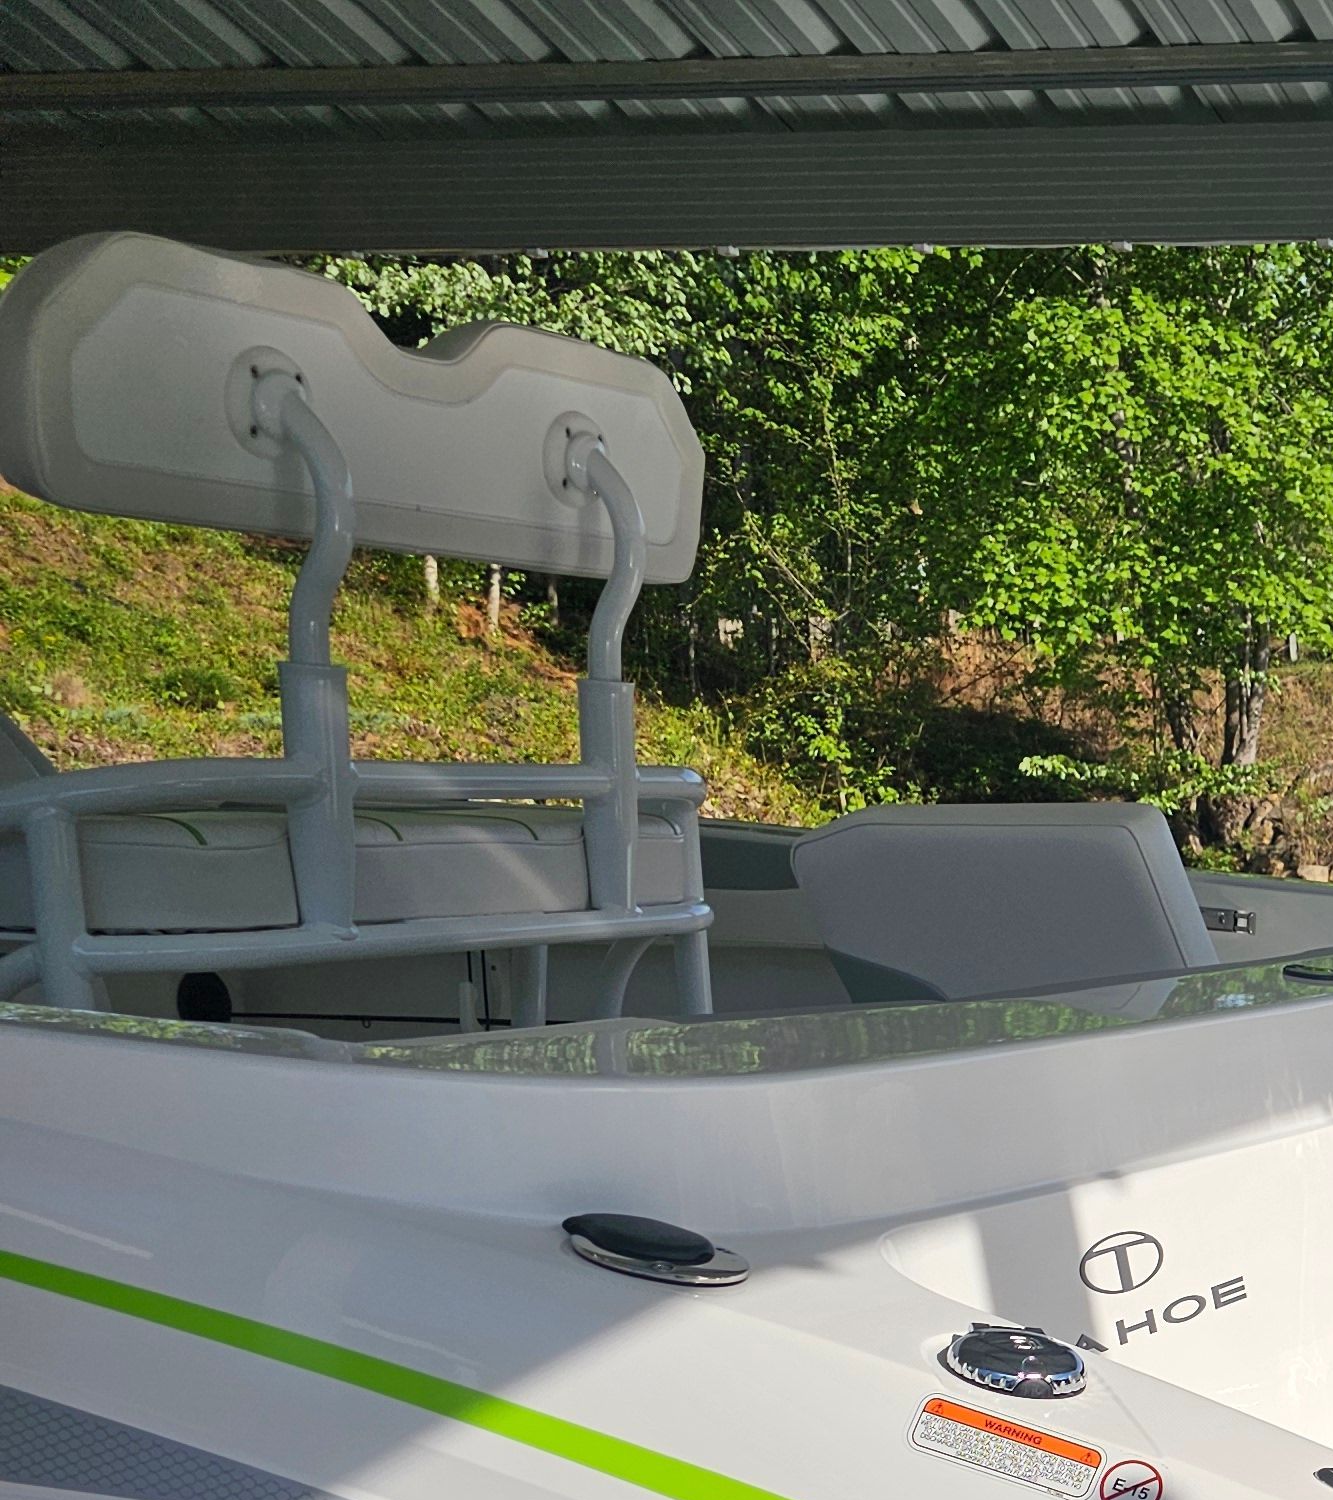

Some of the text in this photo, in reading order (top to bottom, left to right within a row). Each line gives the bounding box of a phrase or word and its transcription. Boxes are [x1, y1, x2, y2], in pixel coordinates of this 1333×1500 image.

[1075, 1276, 1247, 1353] AHOE
[984, 1418, 1043, 1446] WARNING
[1112, 1477, 1150, 1500] E-15
